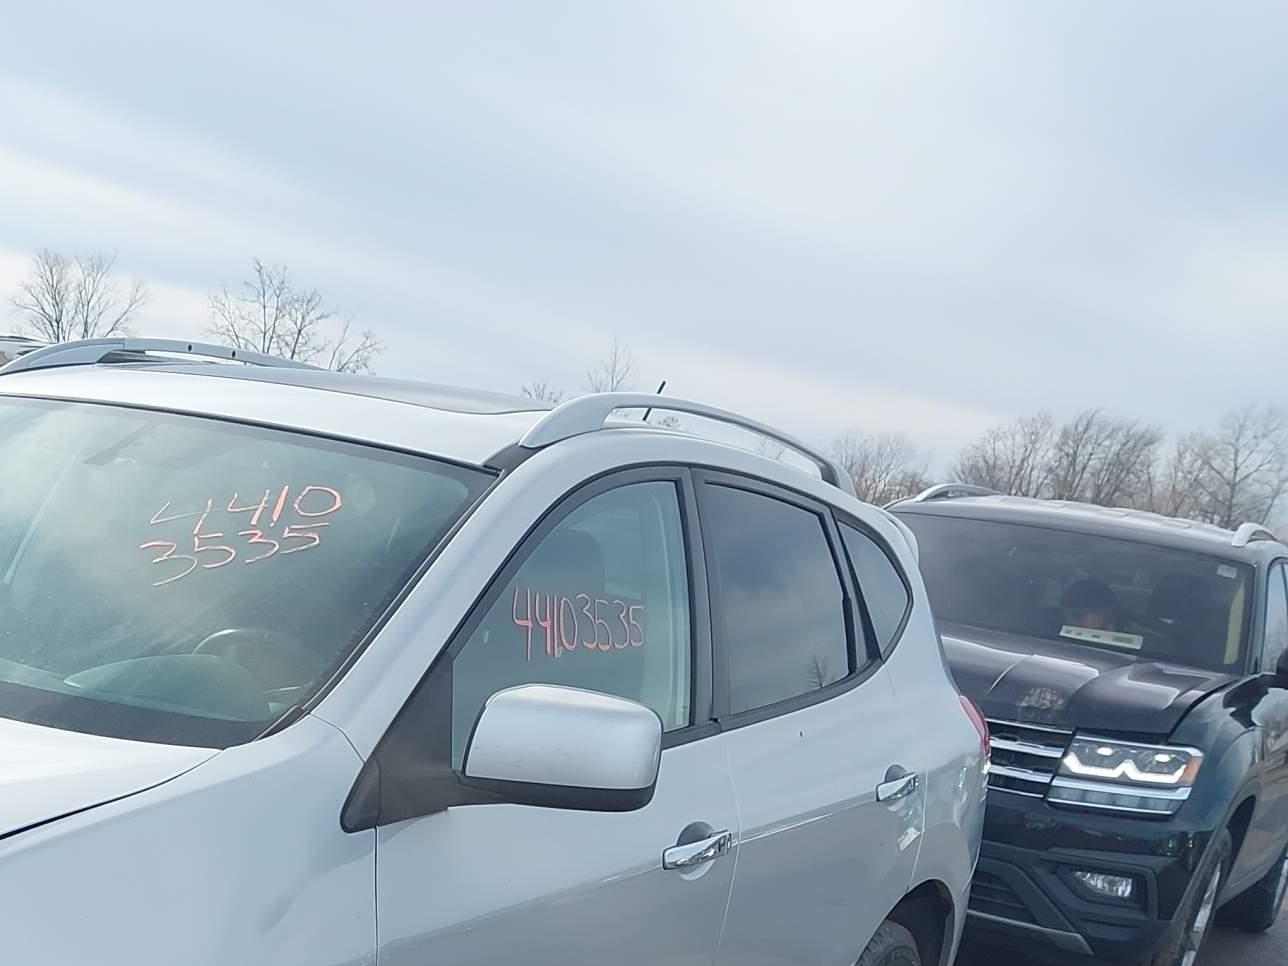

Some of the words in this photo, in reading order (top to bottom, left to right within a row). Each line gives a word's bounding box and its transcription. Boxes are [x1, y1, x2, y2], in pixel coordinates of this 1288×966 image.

[150, 485, 343, 535] 4410
[139, 521, 331, 587] 3535
[512, 586, 645, 663] 44103535
